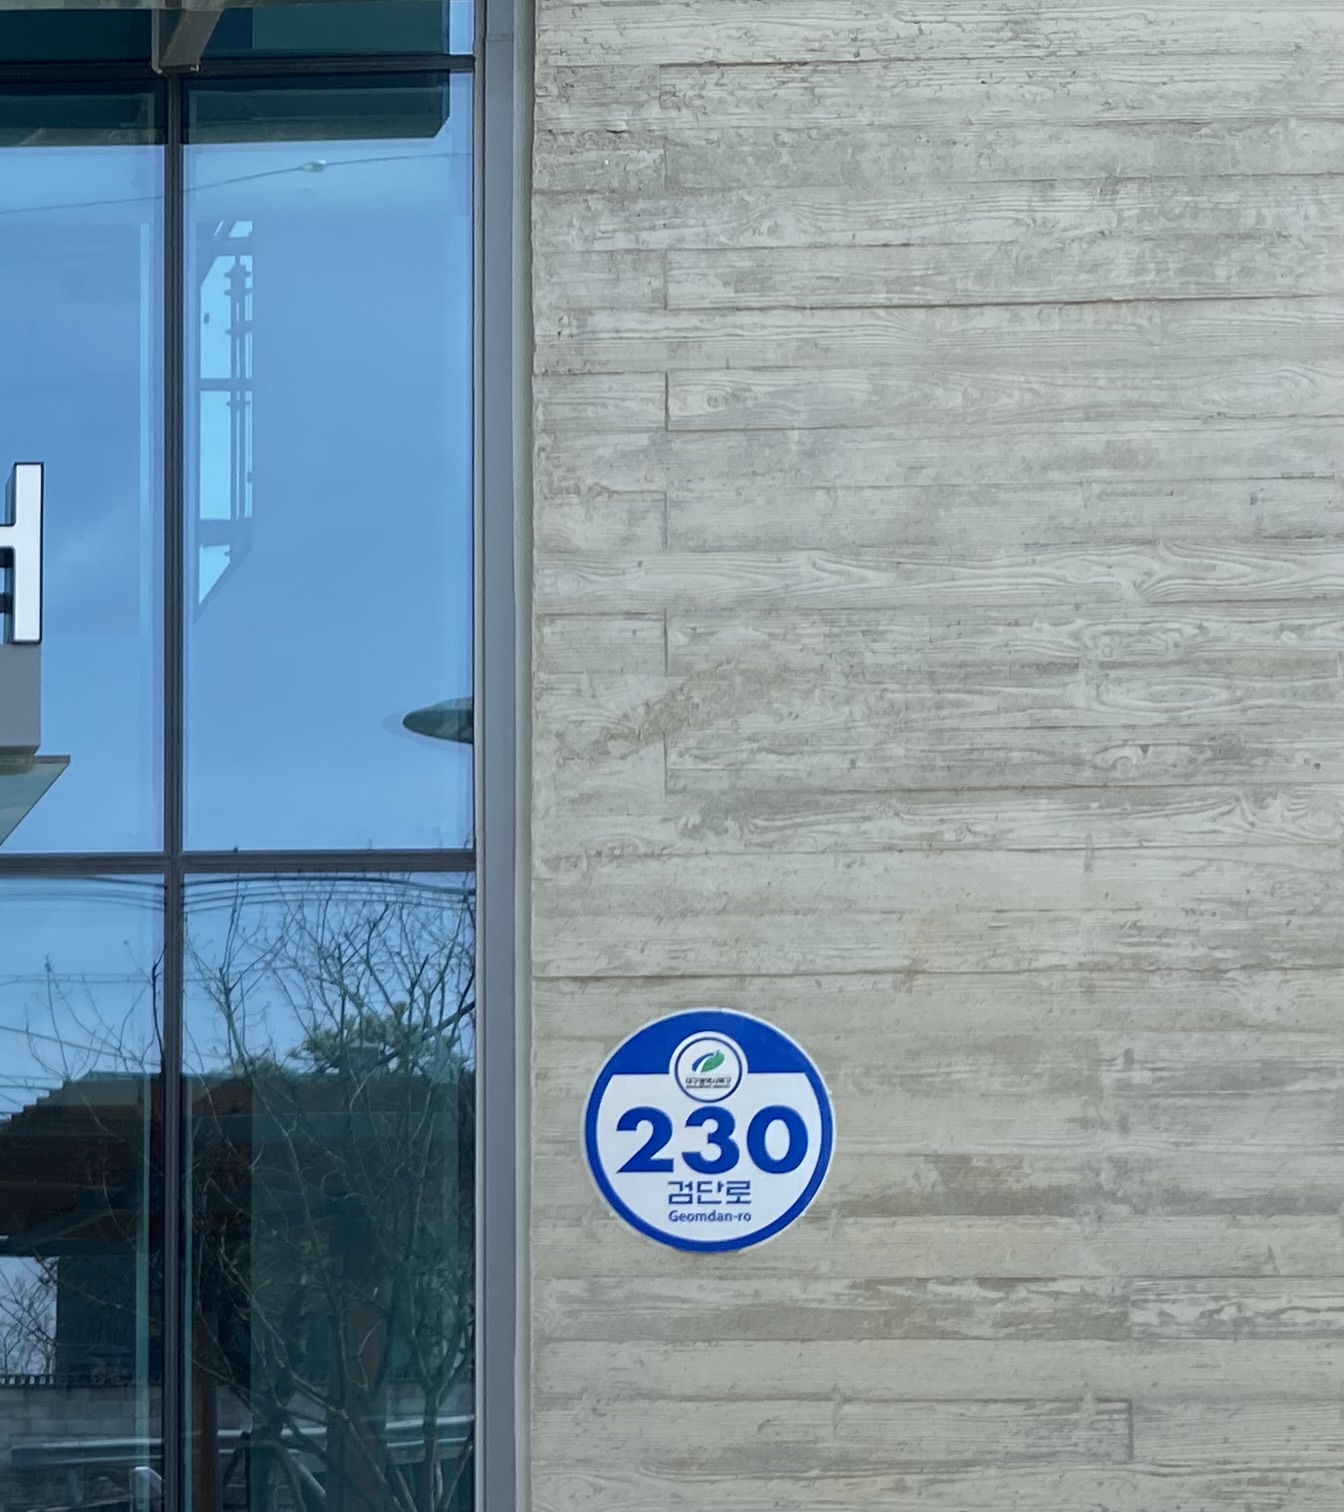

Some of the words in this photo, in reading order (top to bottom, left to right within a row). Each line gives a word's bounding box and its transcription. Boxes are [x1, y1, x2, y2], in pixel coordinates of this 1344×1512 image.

[616, 1105, 809, 1174] 230
[668, 1180, 752, 1205] 검단로
[668, 1210, 752, 1223] Geomdan-ro
